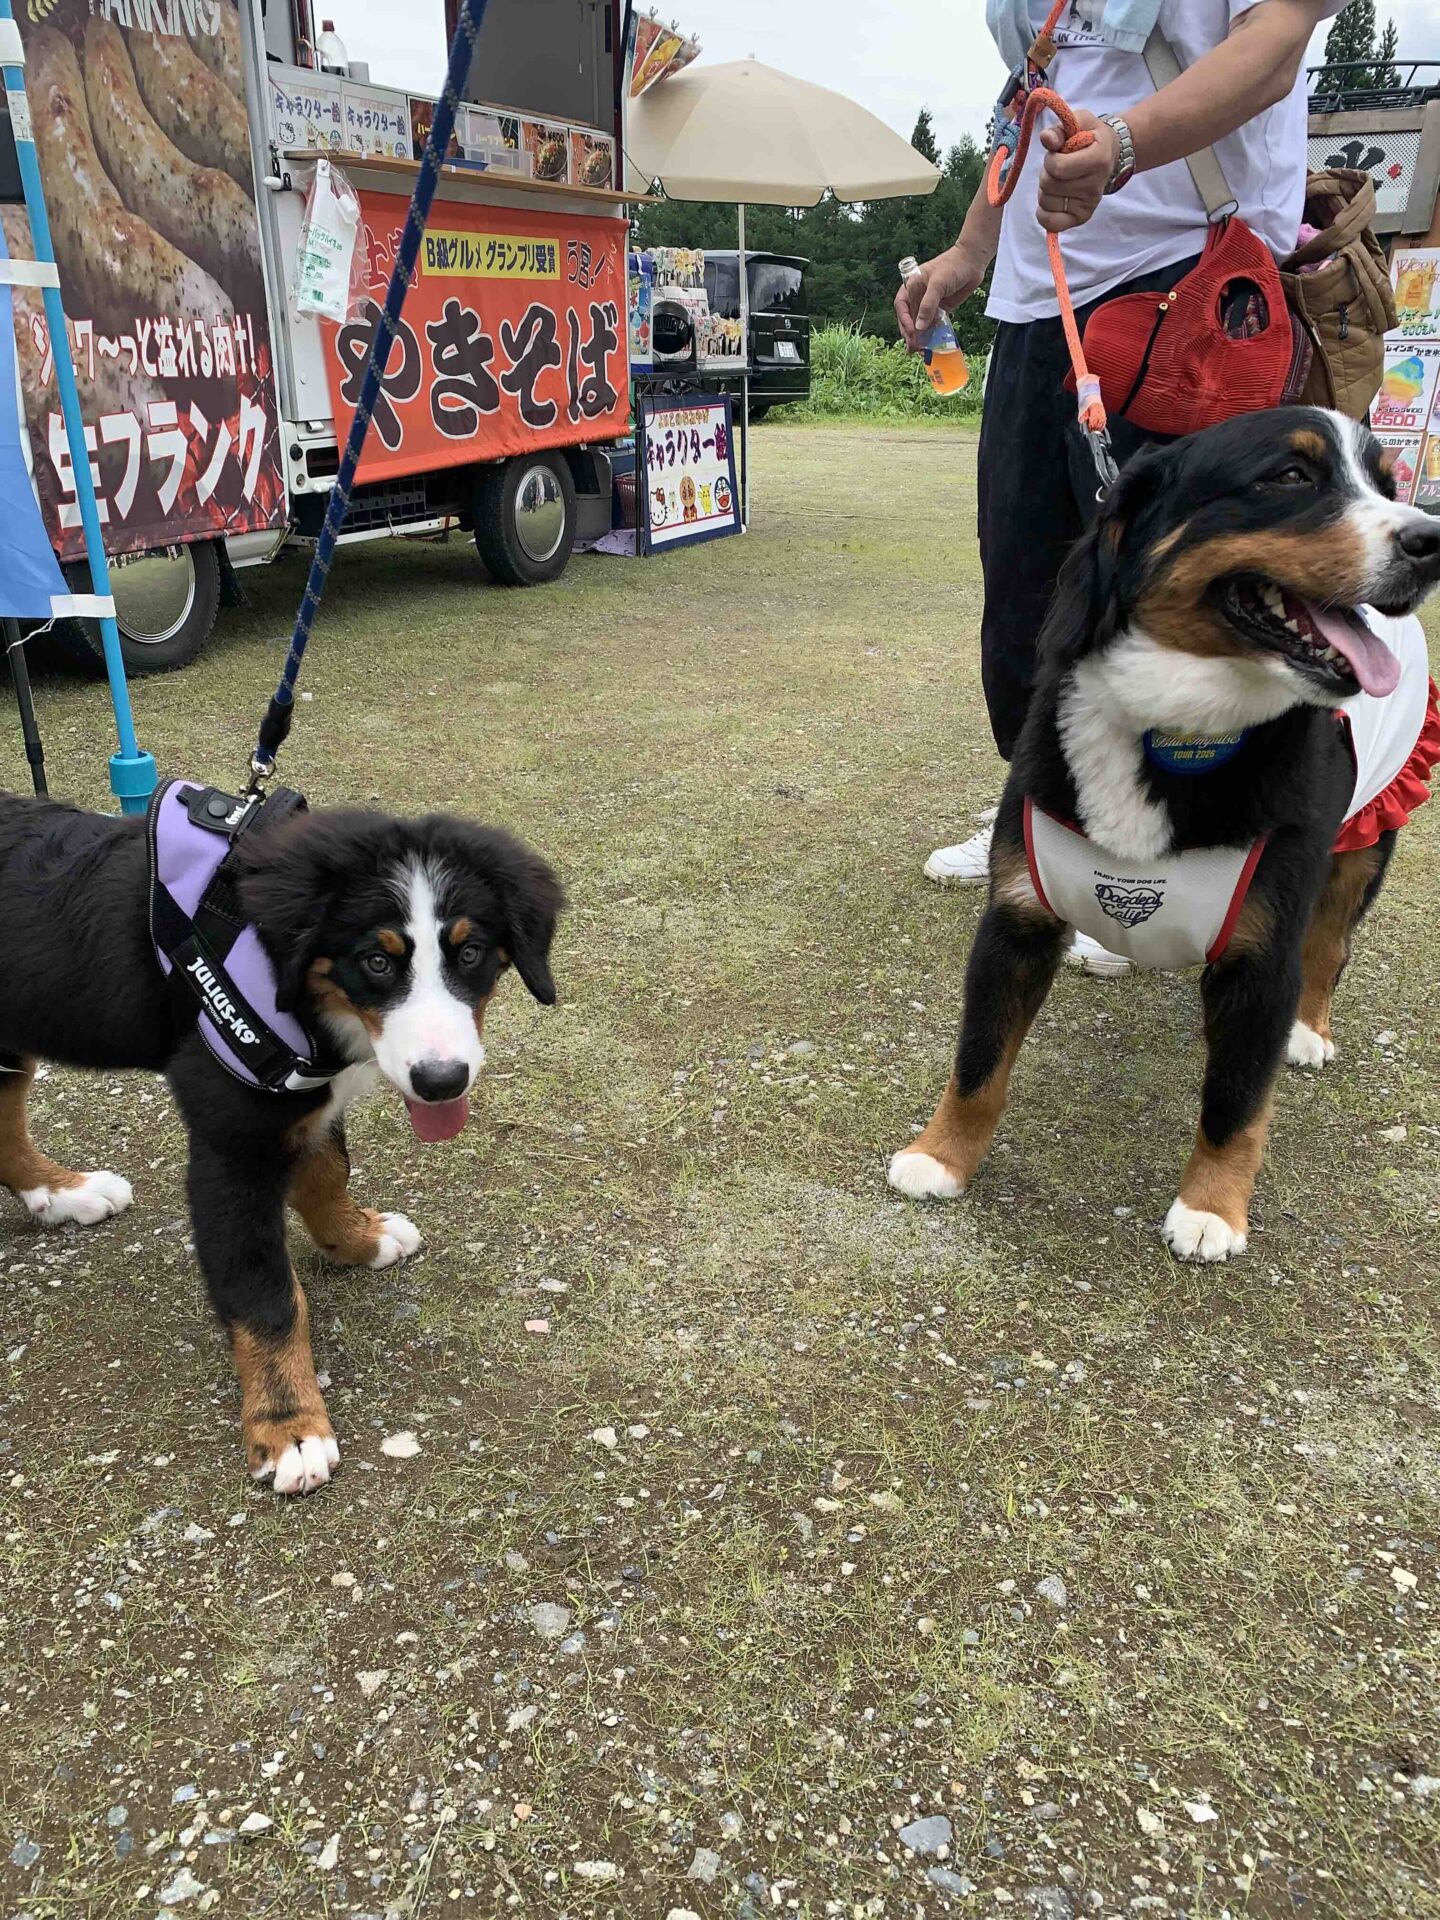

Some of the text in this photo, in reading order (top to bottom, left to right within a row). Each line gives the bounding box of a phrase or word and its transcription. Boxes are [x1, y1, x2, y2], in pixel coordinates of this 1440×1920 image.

[335, 296, 619, 451] やきそば
[1371, 412, 1417, 426] ¥500
[48, 394, 267, 528] 生フランク
[1173, 750, 1194, 759] TOUR
